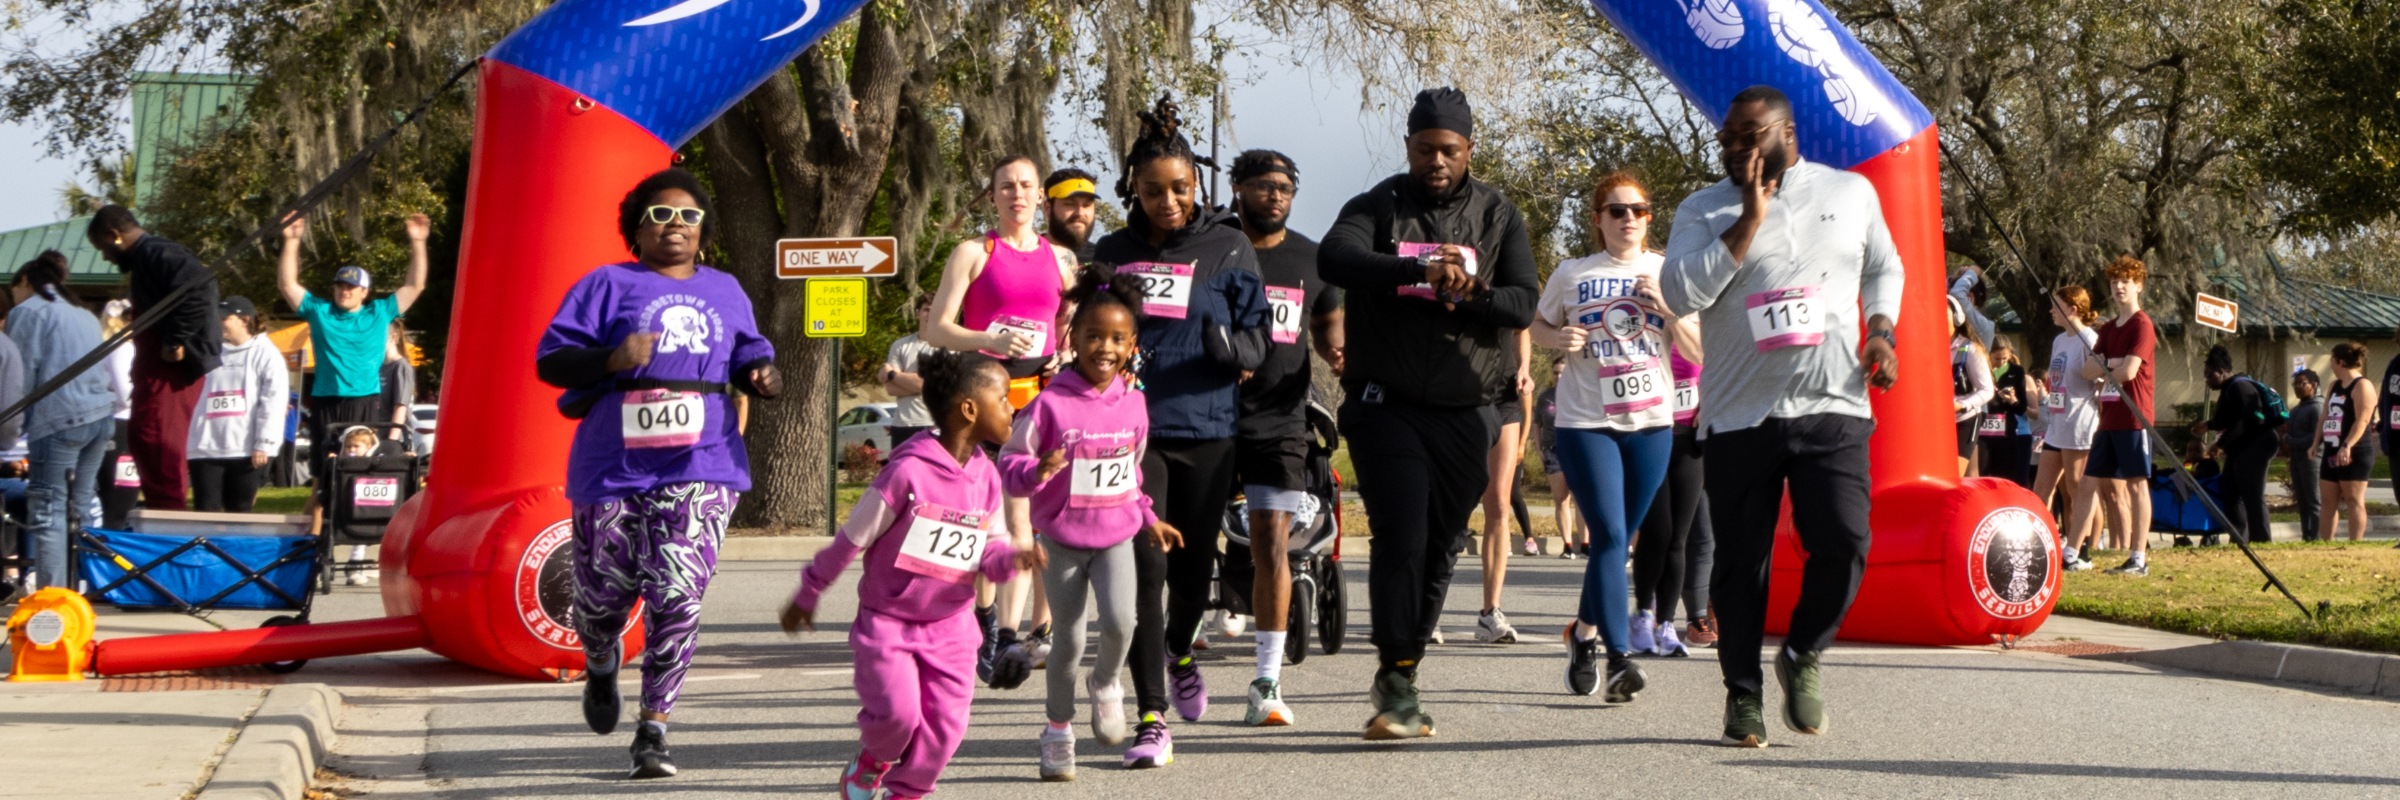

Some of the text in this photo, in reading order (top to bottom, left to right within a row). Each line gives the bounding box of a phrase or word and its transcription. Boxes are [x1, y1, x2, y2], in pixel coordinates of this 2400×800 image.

[789, 250, 859, 266] ONE WAY
[823, 286, 849, 294] PARK
[1142, 277, 1175, 298] 22
[815, 297, 857, 306] CLOSES
[830, 308, 842, 317] AT
[1763, 302, 1810, 330] 113
[846, 319, 860, 328] PM
[1613, 374, 1653, 398] 098
[212, 397, 236, 409] 061
[1676, 389, 1692, 407] 17
[637, 403, 690, 430] 040
[1982, 420, 2000, 430] 053
[1090, 460, 1129, 488] 124
[363, 485, 388, 497] 080
[928, 526, 977, 561] 123
